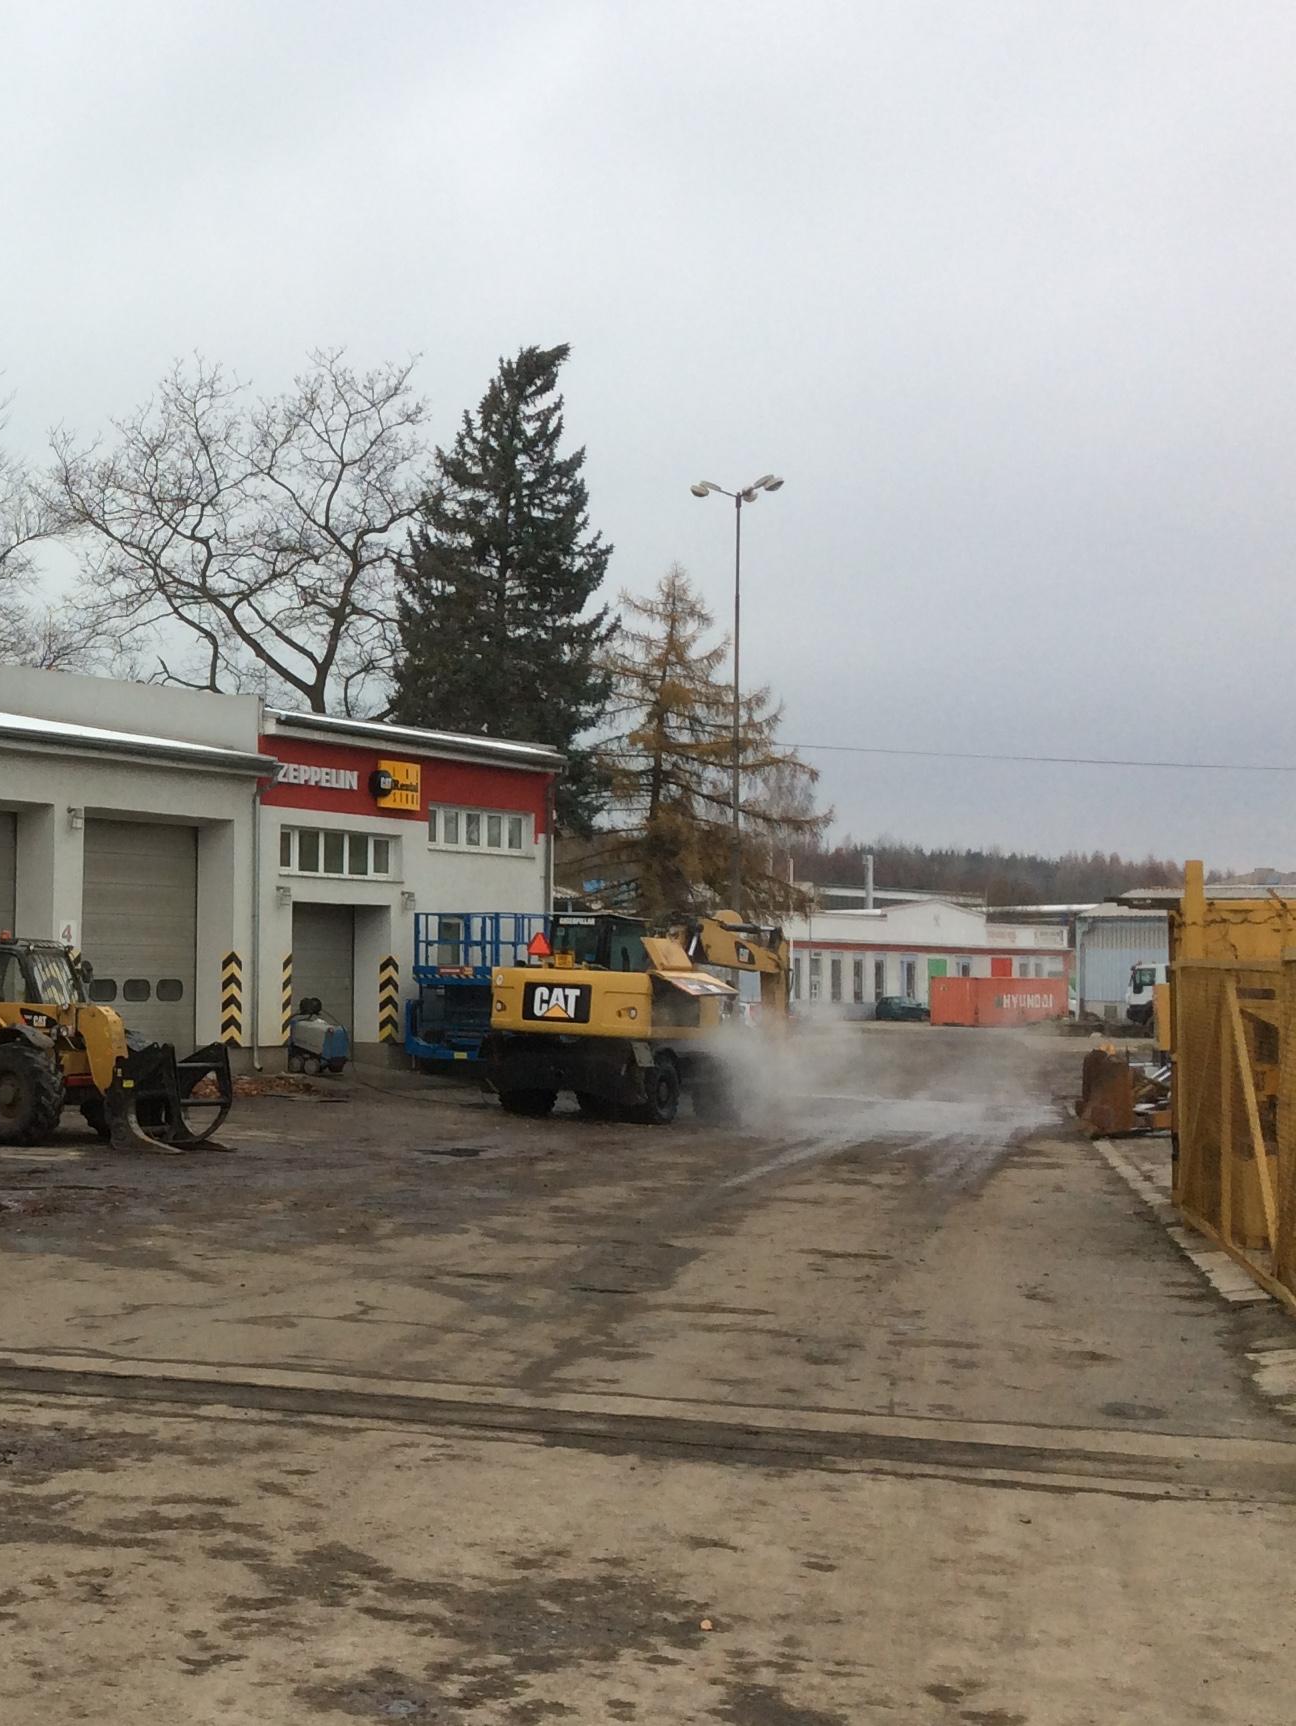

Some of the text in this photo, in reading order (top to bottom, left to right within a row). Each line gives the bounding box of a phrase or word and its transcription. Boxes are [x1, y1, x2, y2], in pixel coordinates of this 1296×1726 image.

[277, 762, 359, 791] ZEPPELIN
[62, 924, 72, 942] 4
[533, 986, 581, 1019] CAT
[32, 1015, 47, 1028] CAT
